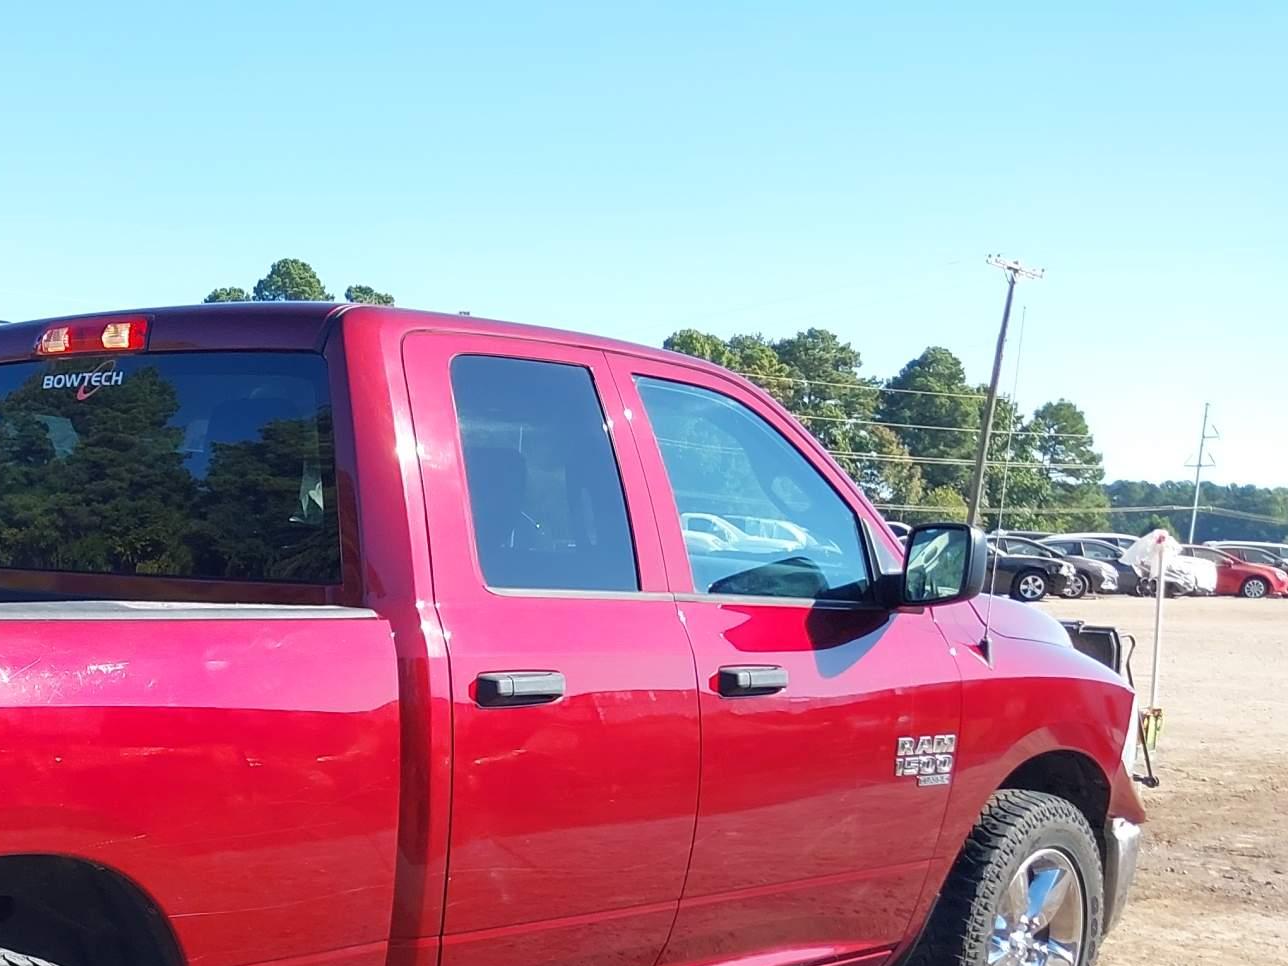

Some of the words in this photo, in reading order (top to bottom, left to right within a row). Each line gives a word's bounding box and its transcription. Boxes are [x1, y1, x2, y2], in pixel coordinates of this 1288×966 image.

[42, 371, 124, 389] BOWTECH
[897, 734, 956, 756] RAM
[895, 754, 953, 776] 1500
